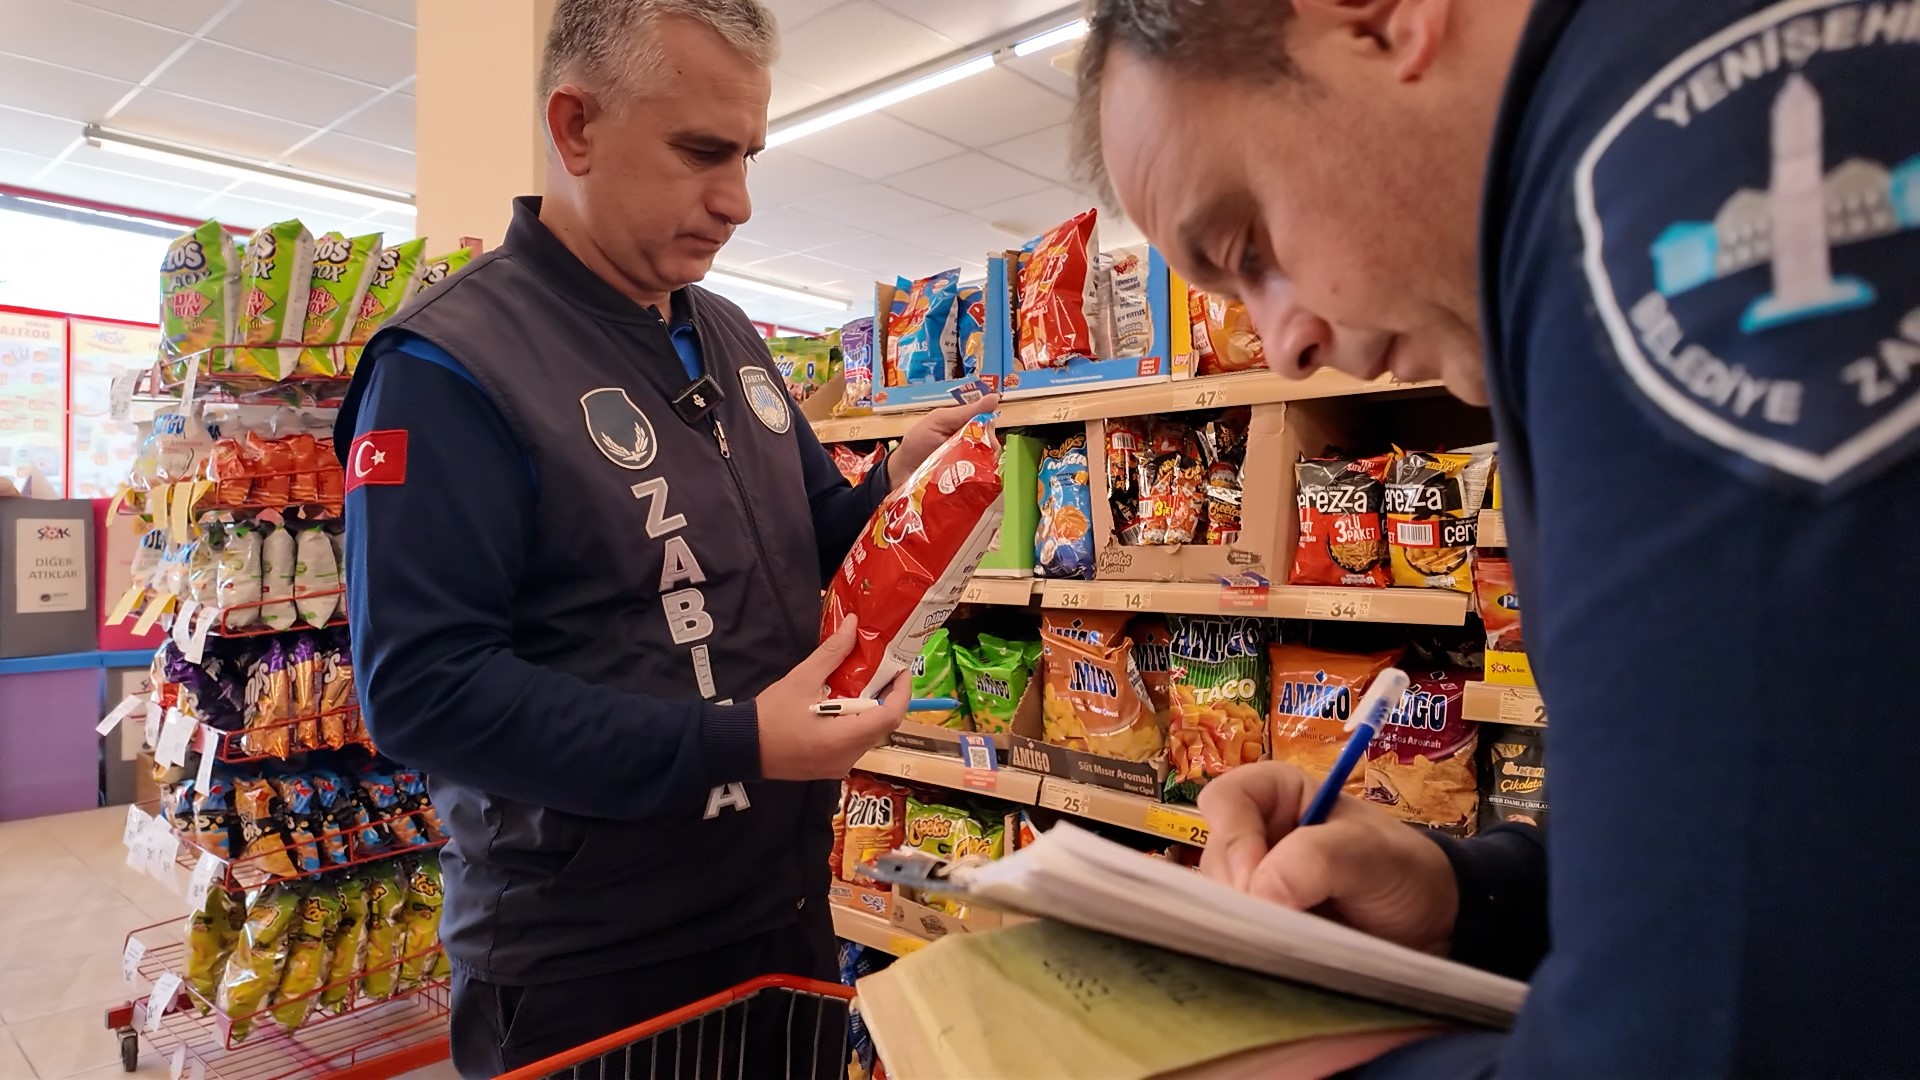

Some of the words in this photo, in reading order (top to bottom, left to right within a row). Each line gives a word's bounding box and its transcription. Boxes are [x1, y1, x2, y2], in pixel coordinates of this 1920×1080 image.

[1195, 391, 1216, 407] 47
[1053, 407, 1071, 421] 47
[849, 426, 861, 438] 87
[1297, 485, 1367, 514] erezza
[1385, 484, 1442, 513] erezza
[1347, 527, 1375, 542] PAKET
[28, 570, 78, 580] ATIKLAR
[1061, 593, 1079, 607] 34
[1125, 593, 1142, 608] 14
[1330, 601, 1356, 618] 34
[631, 477, 751, 820] ZABIA
[1192, 678, 1257, 706] TACO
[1078, 760, 1094, 772] Süt
[1094, 764, 1115, 777] Mısır
[1116, 768, 1153, 785] Aromalı
[1500, 776, 1543, 794] Çikolata
[1063, 796, 1080, 813] 25
[1189, 826, 1209, 845] 25
